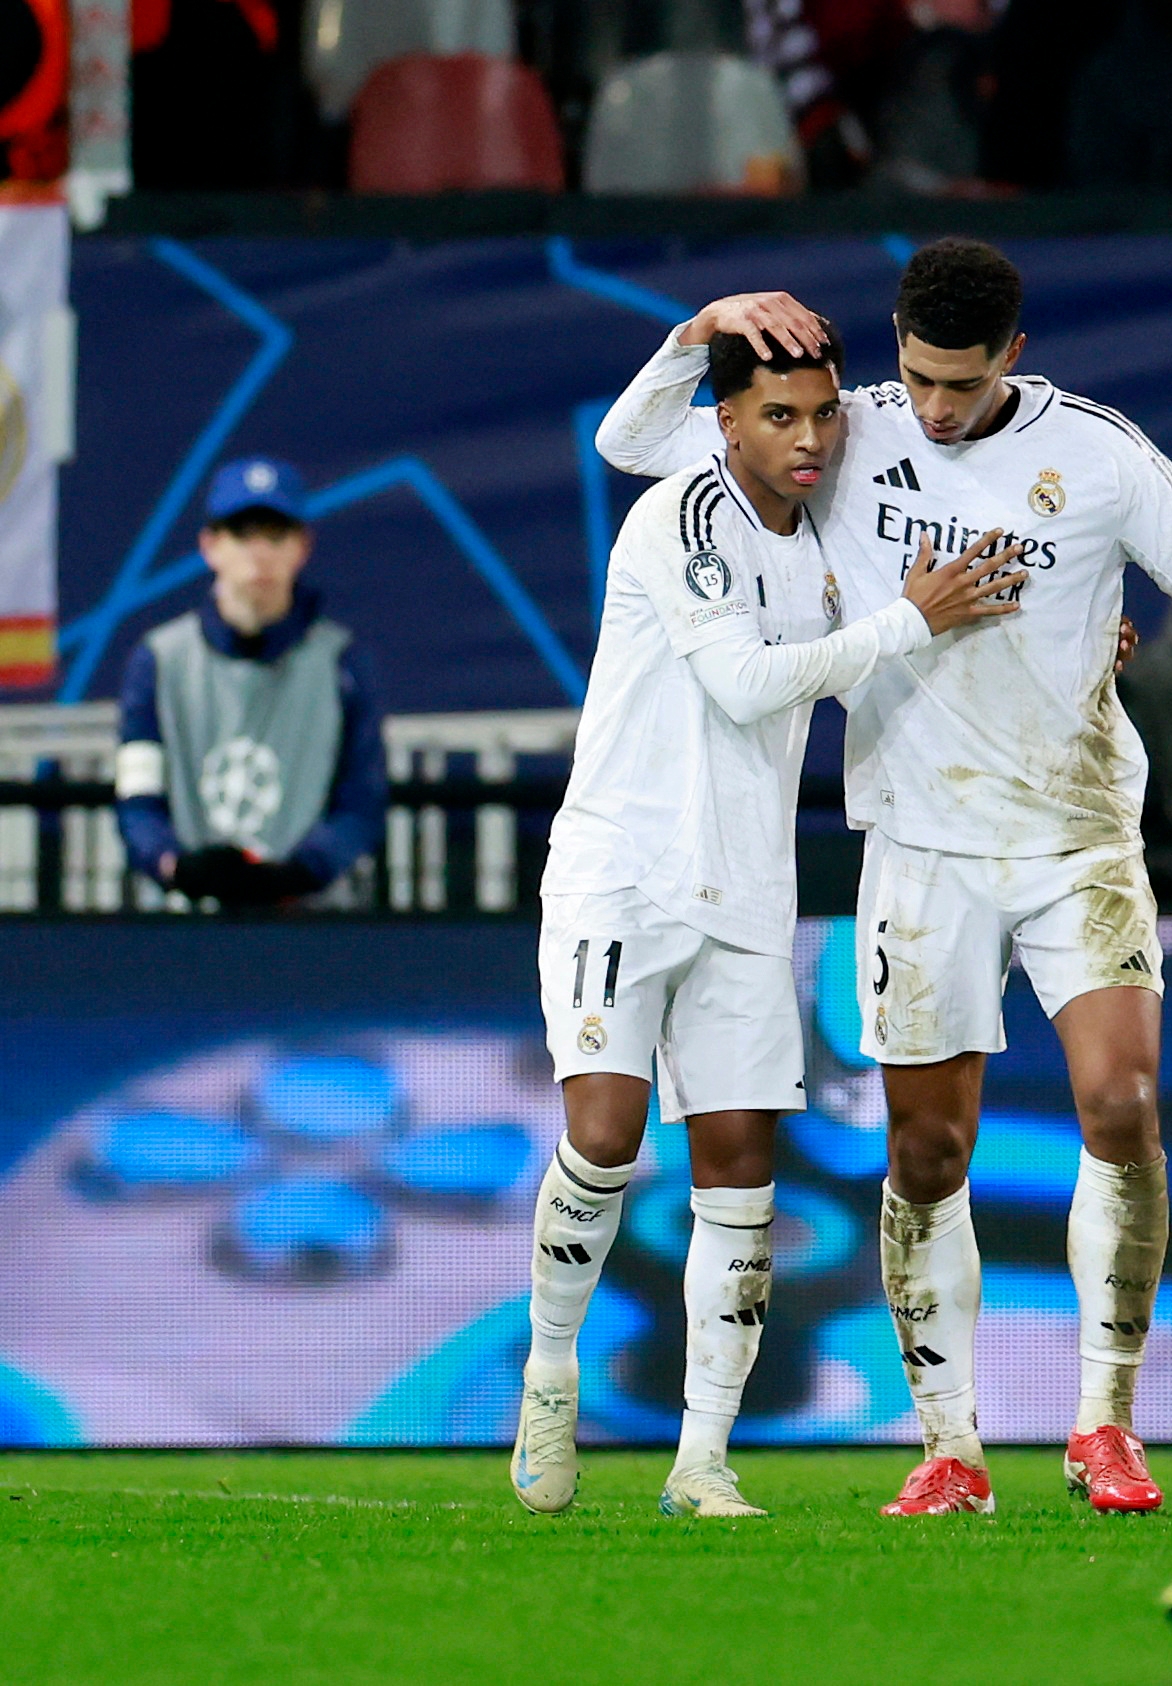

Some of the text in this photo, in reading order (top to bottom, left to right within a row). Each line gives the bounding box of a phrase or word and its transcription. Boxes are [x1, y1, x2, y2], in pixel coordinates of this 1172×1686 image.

[703, 573, 718, 588] 15
[691, 601, 748, 626] FOUNDATION
[573, 939, 623, 1009] 11
[550, 1196, 606, 1222] RMCF
[728, 1257, 773, 1272] RMC
